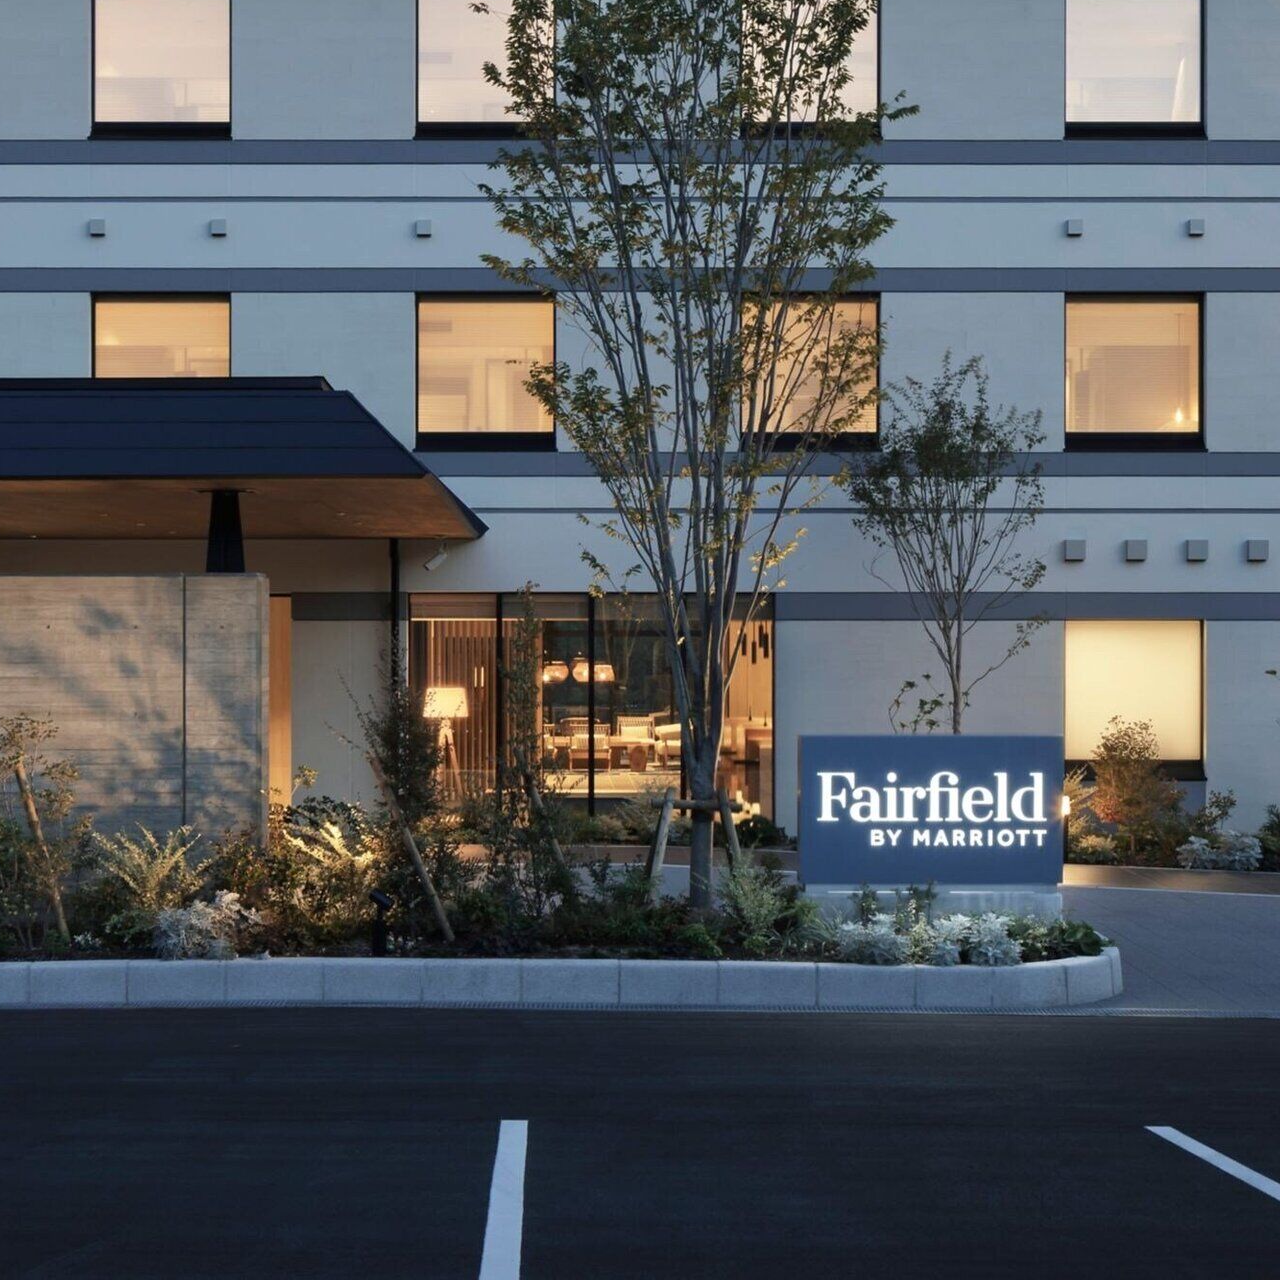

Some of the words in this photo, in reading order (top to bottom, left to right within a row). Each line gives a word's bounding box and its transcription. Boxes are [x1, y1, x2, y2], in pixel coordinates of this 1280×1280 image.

[816, 771, 1048, 823] Fairfield
[870, 829, 902, 847] BY
[912, 829, 1048, 847] MARRIOTT
